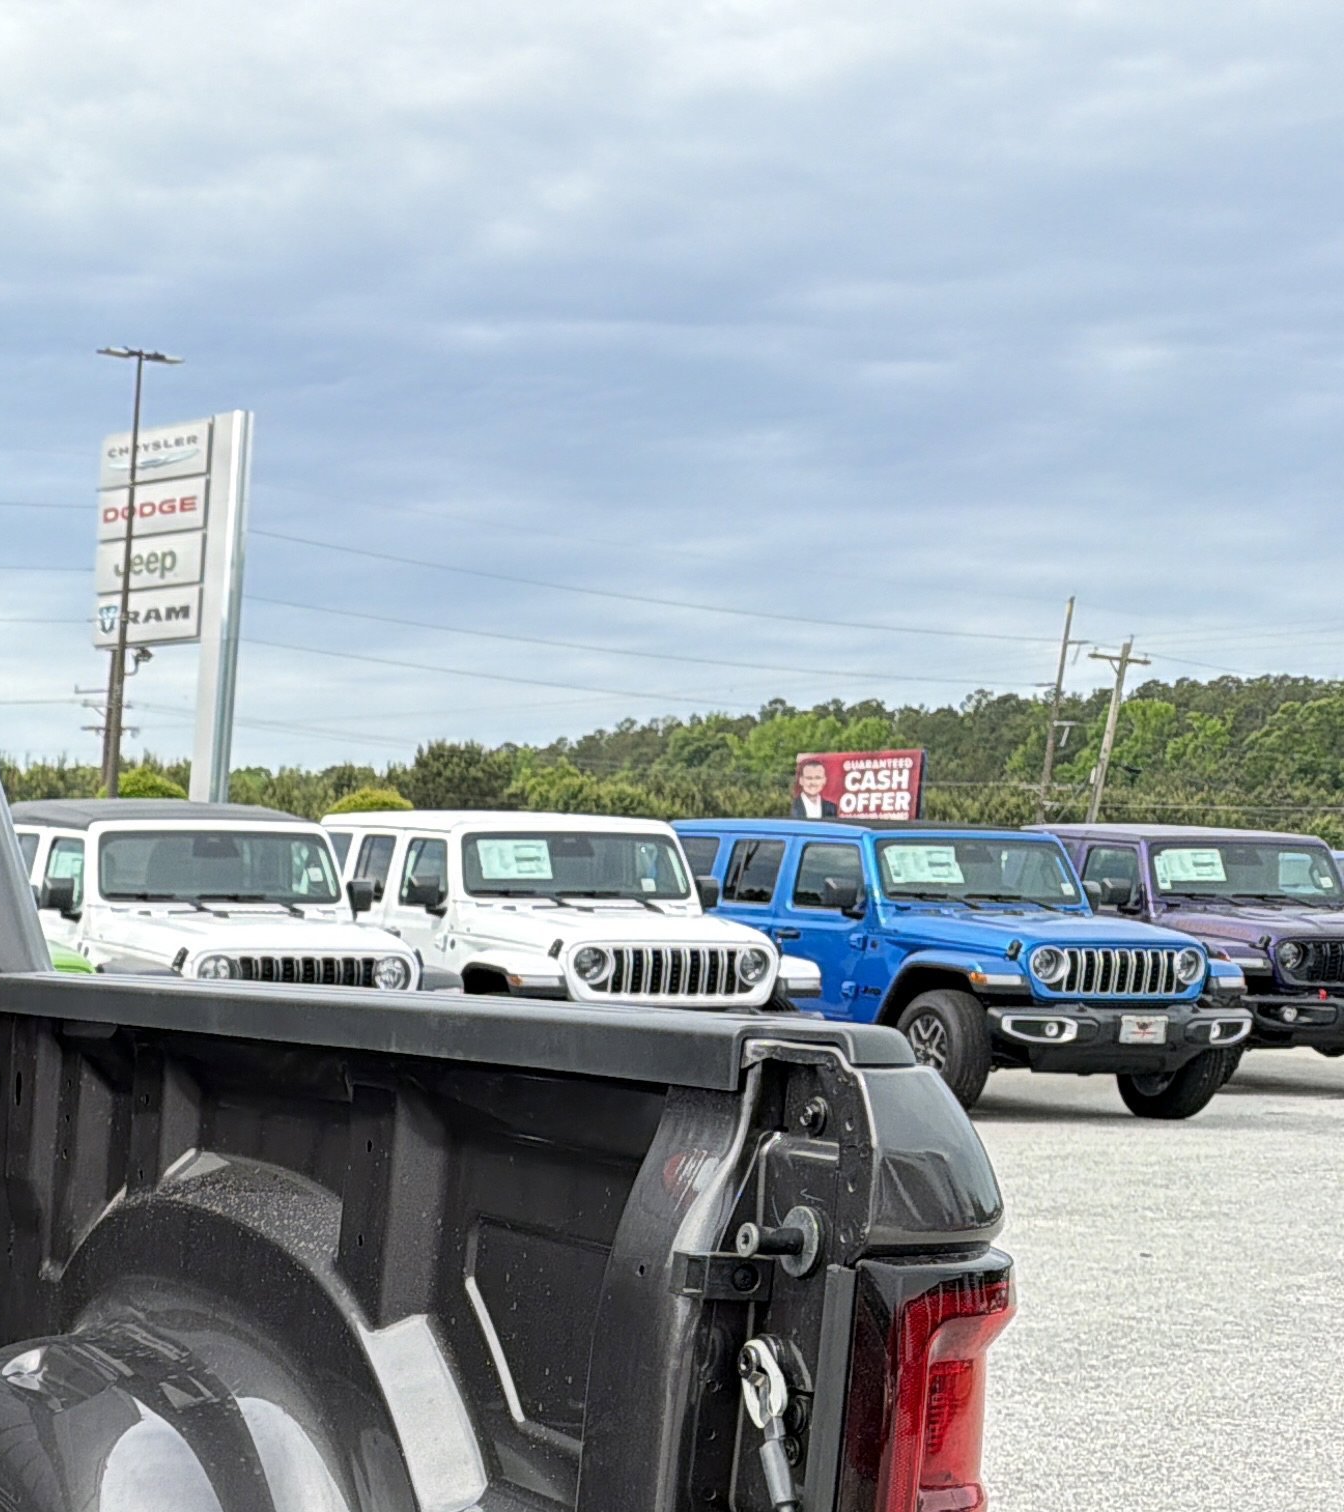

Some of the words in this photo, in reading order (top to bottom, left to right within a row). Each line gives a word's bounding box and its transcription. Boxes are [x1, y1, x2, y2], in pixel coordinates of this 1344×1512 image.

[107, 434, 198, 458] CHYSLER
[103, 496, 197, 524] DODGE
[123, 605, 190, 624] RAM
[843, 757, 913, 772] GUARANTEED
[844, 769, 910, 792] CASH
[839, 791, 912, 813] OFFER
